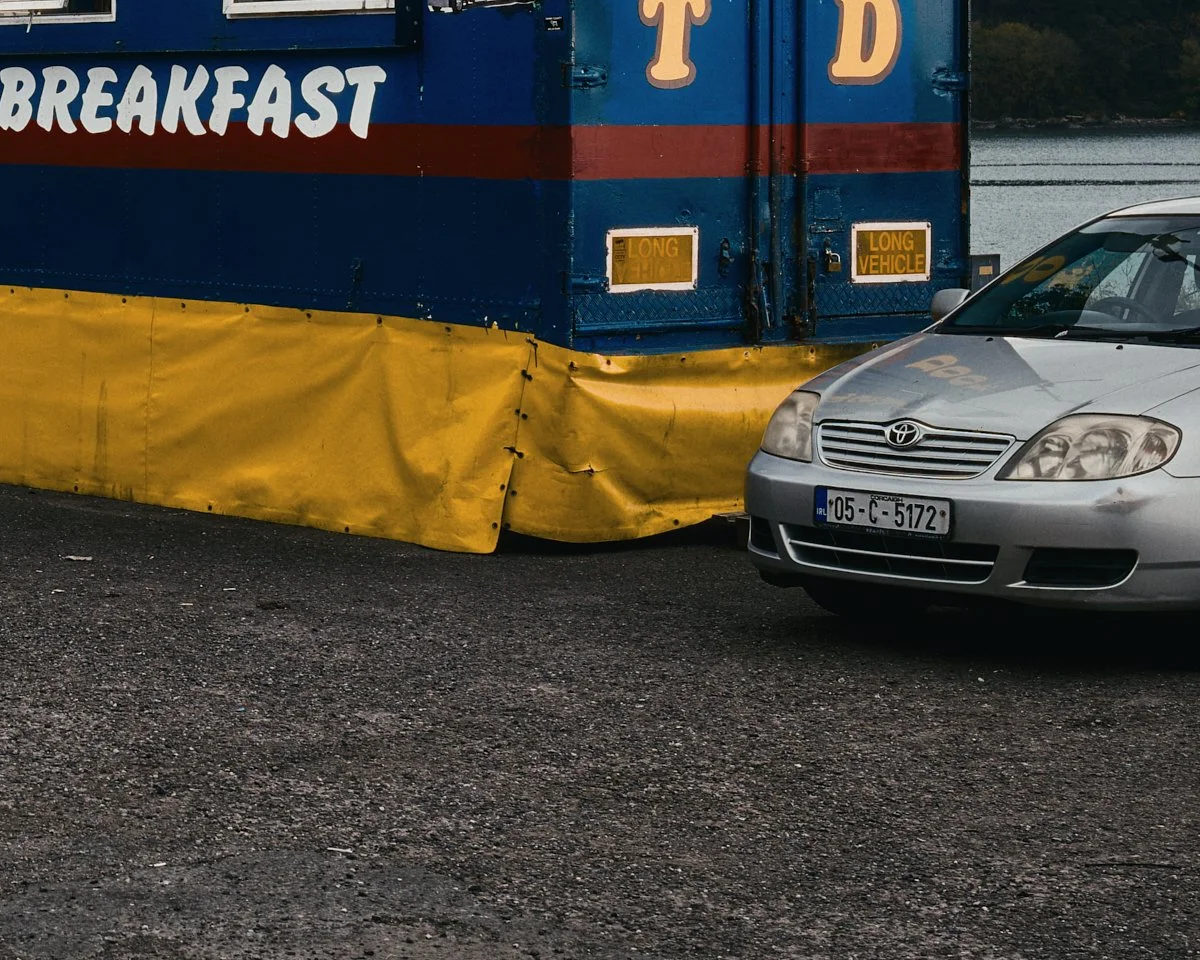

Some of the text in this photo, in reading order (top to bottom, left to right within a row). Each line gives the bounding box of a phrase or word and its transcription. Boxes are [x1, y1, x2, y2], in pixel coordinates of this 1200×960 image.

[628, 236, 679, 258] LONG
[869, 230, 914, 252] LONG
[858, 253, 926, 275] VEHICLE
[816, 507, 827, 516] IRL
